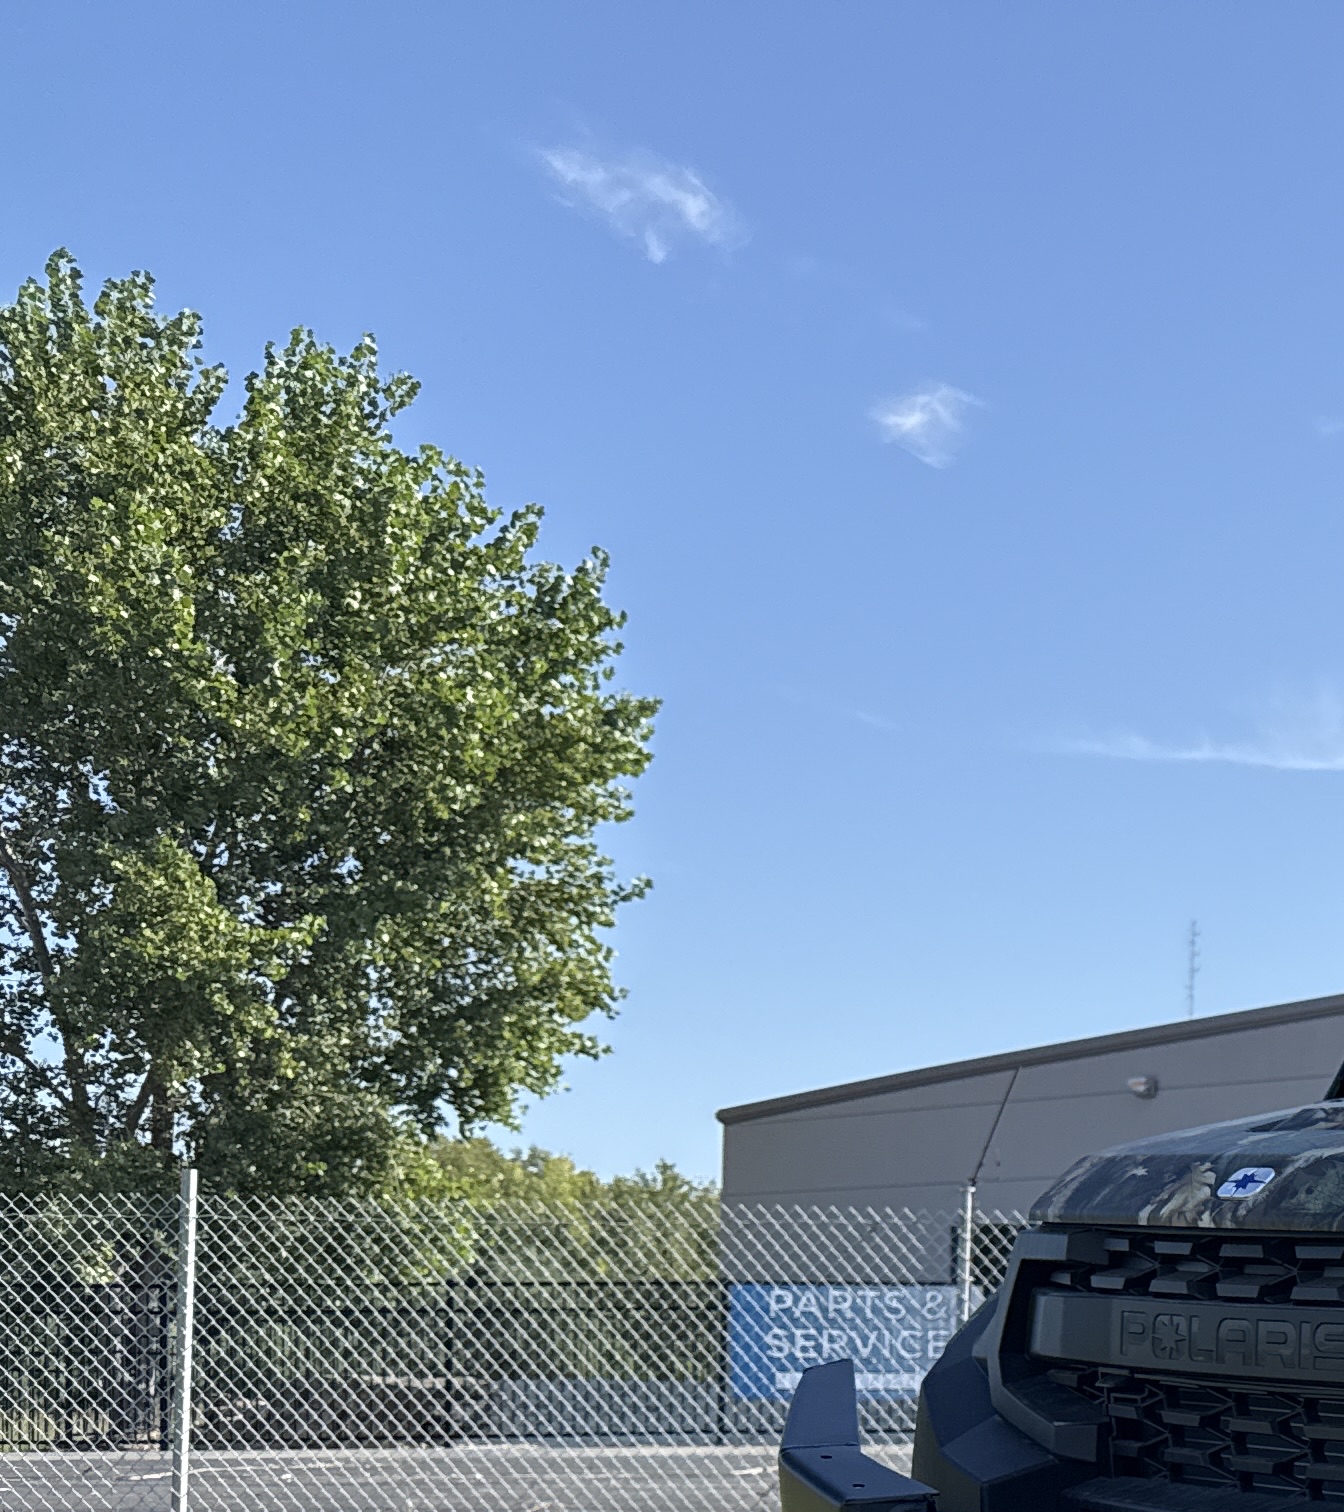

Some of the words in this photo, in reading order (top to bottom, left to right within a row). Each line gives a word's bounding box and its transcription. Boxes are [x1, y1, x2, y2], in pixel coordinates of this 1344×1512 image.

[768, 1289, 906, 1320] PARTS
[922, 1290, 948, 1320] &
[766, 1328, 951, 1359] SERVICE
